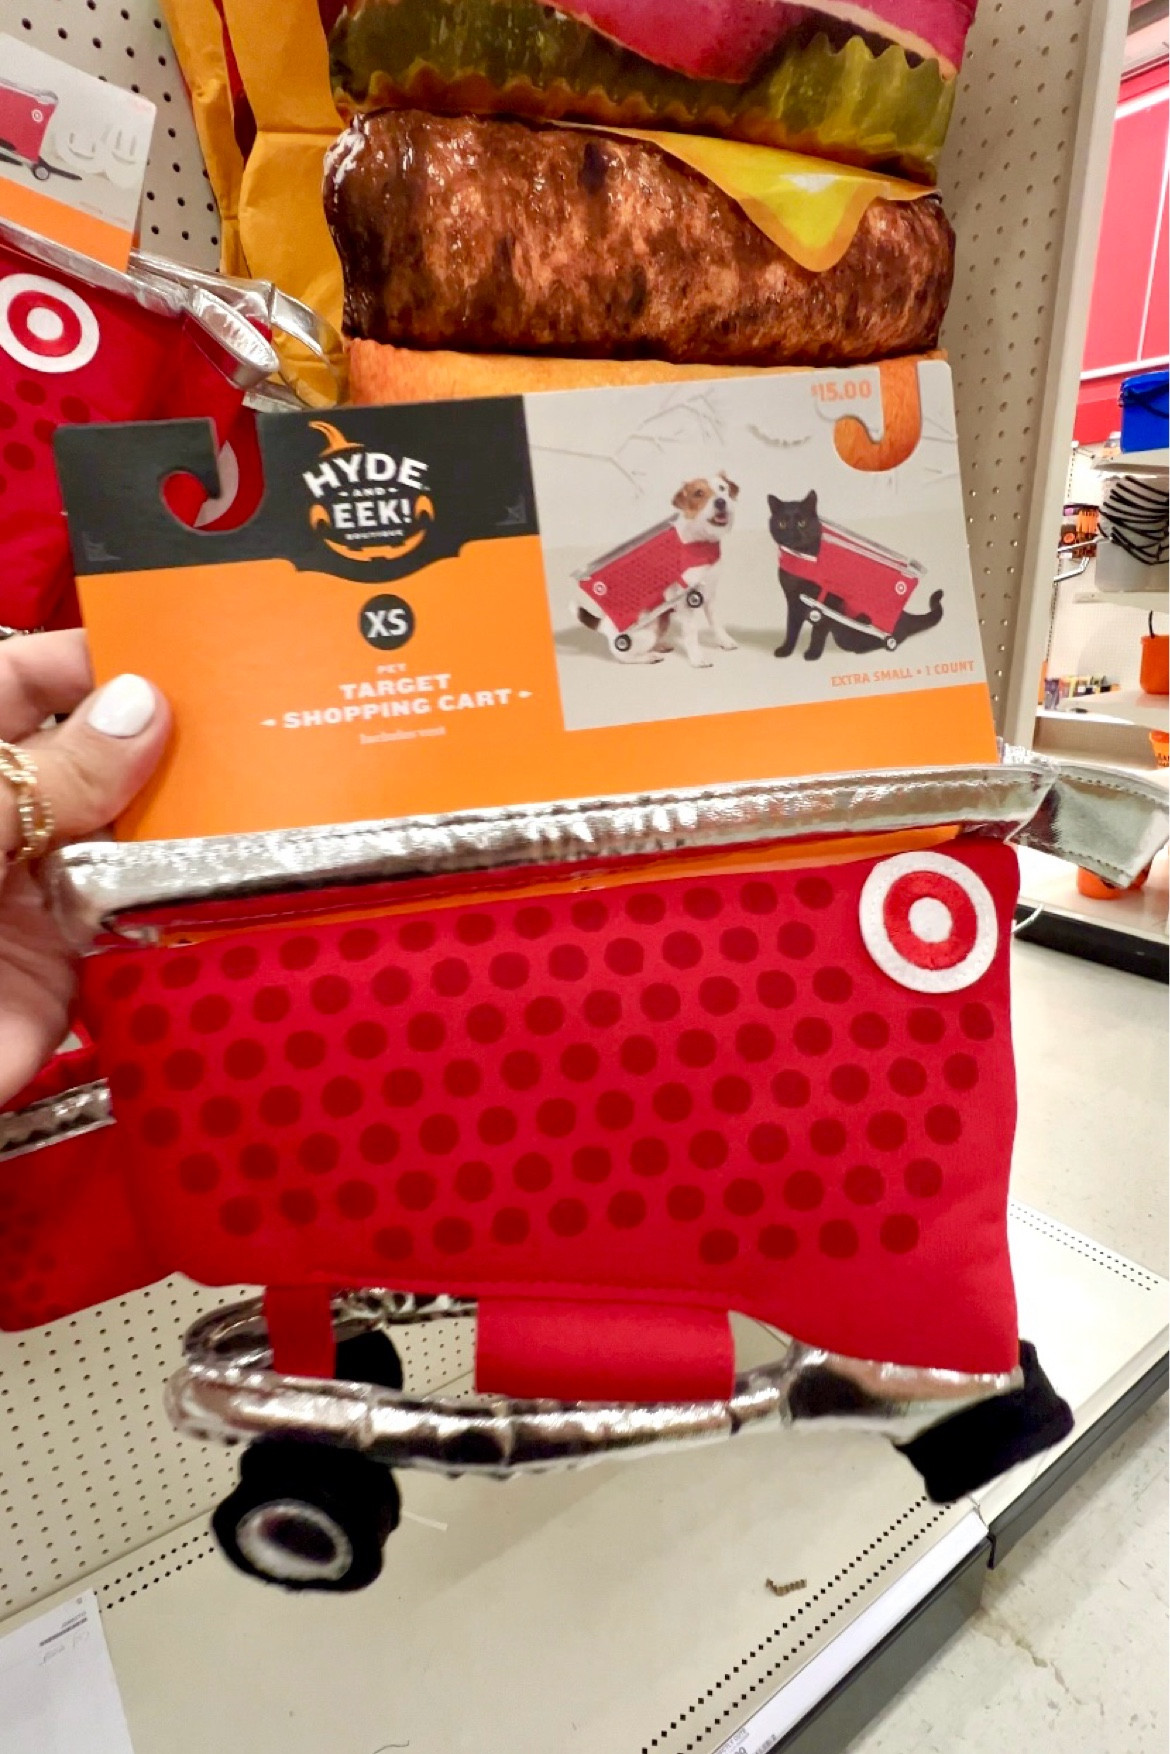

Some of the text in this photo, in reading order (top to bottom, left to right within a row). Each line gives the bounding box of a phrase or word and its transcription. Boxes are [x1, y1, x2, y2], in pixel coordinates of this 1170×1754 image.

[303, 453, 429, 498] HYDE
[332, 498, 412, 529] EEK!
[365, 608, 408, 638] XS
[339, 673, 451, 700] TARGET
[831, 673, 871, 688] EXTRA
[873, 667, 914, 683] SMALL
[934, 660, 975, 674] COUNT
[283, 688, 512, 729] SHOPPING CART
